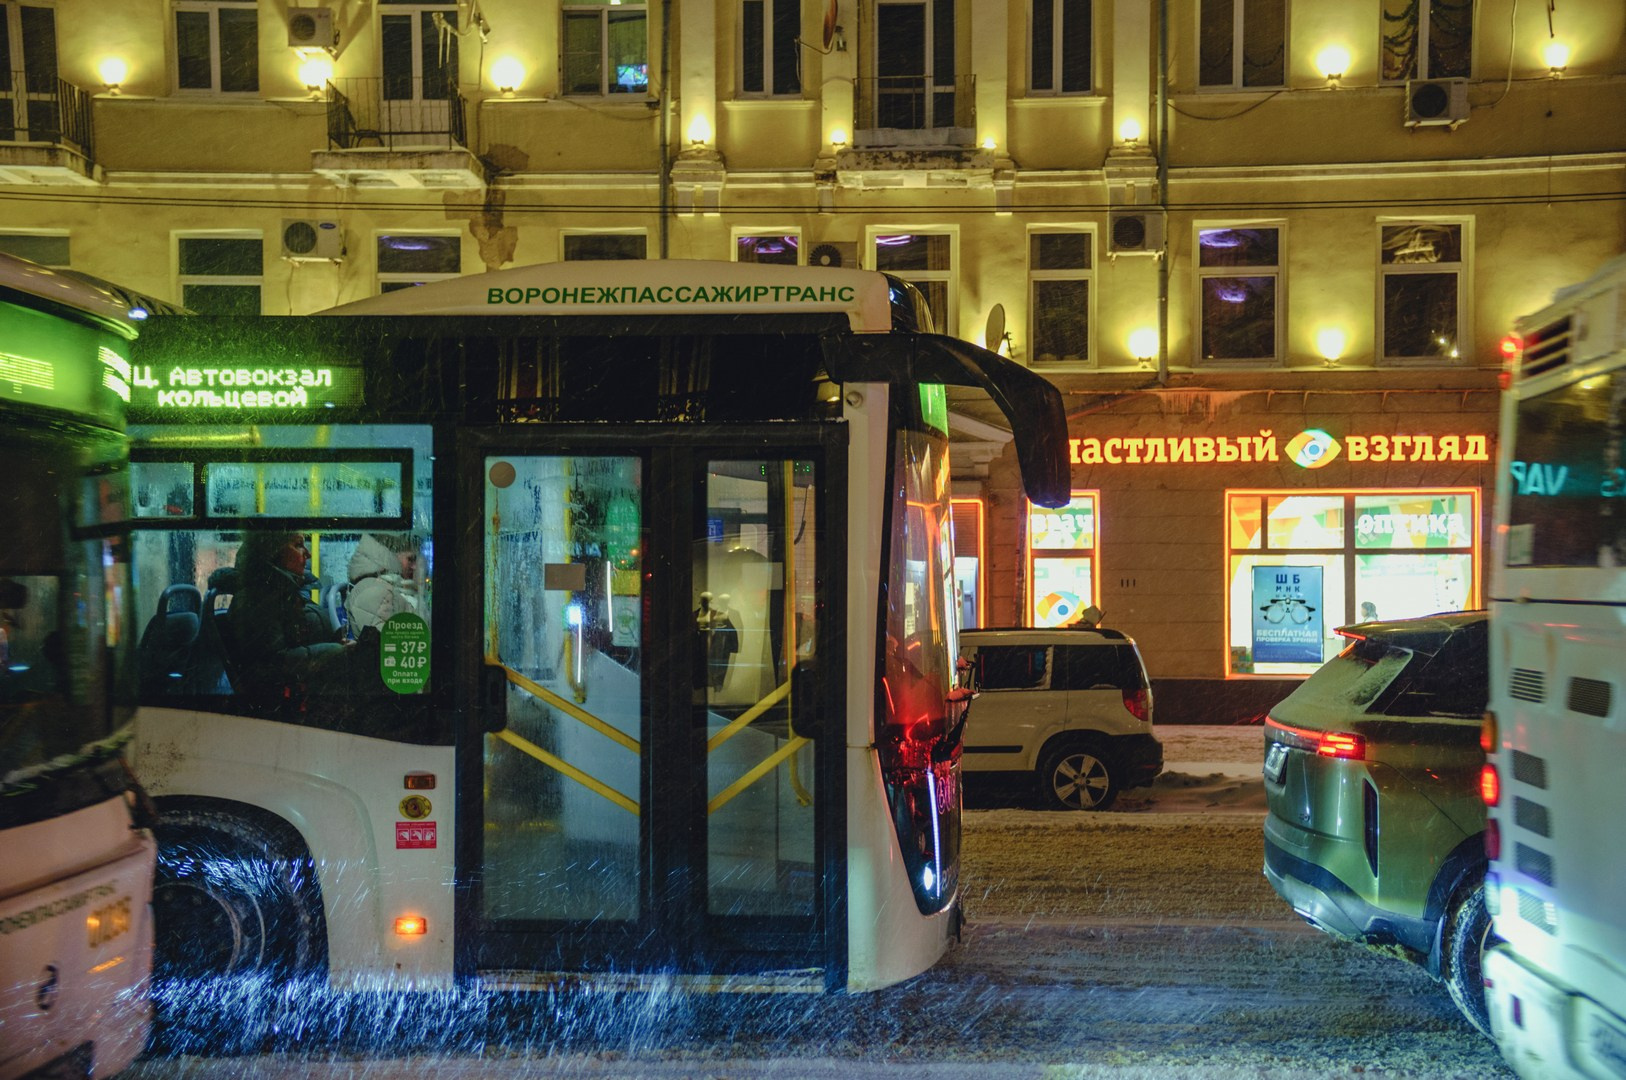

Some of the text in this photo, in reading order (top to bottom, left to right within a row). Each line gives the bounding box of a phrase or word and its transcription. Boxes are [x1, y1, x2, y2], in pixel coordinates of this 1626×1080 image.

[487, 285, 855, 304] ВОРОНЕЖПАССАЖИРТРАНС
[1358, 513, 1464, 534] оптика
[388, 620, 423, 631] Проезд
[1256, 629, 1318, 637] БЕСПЛАТНАЯ
